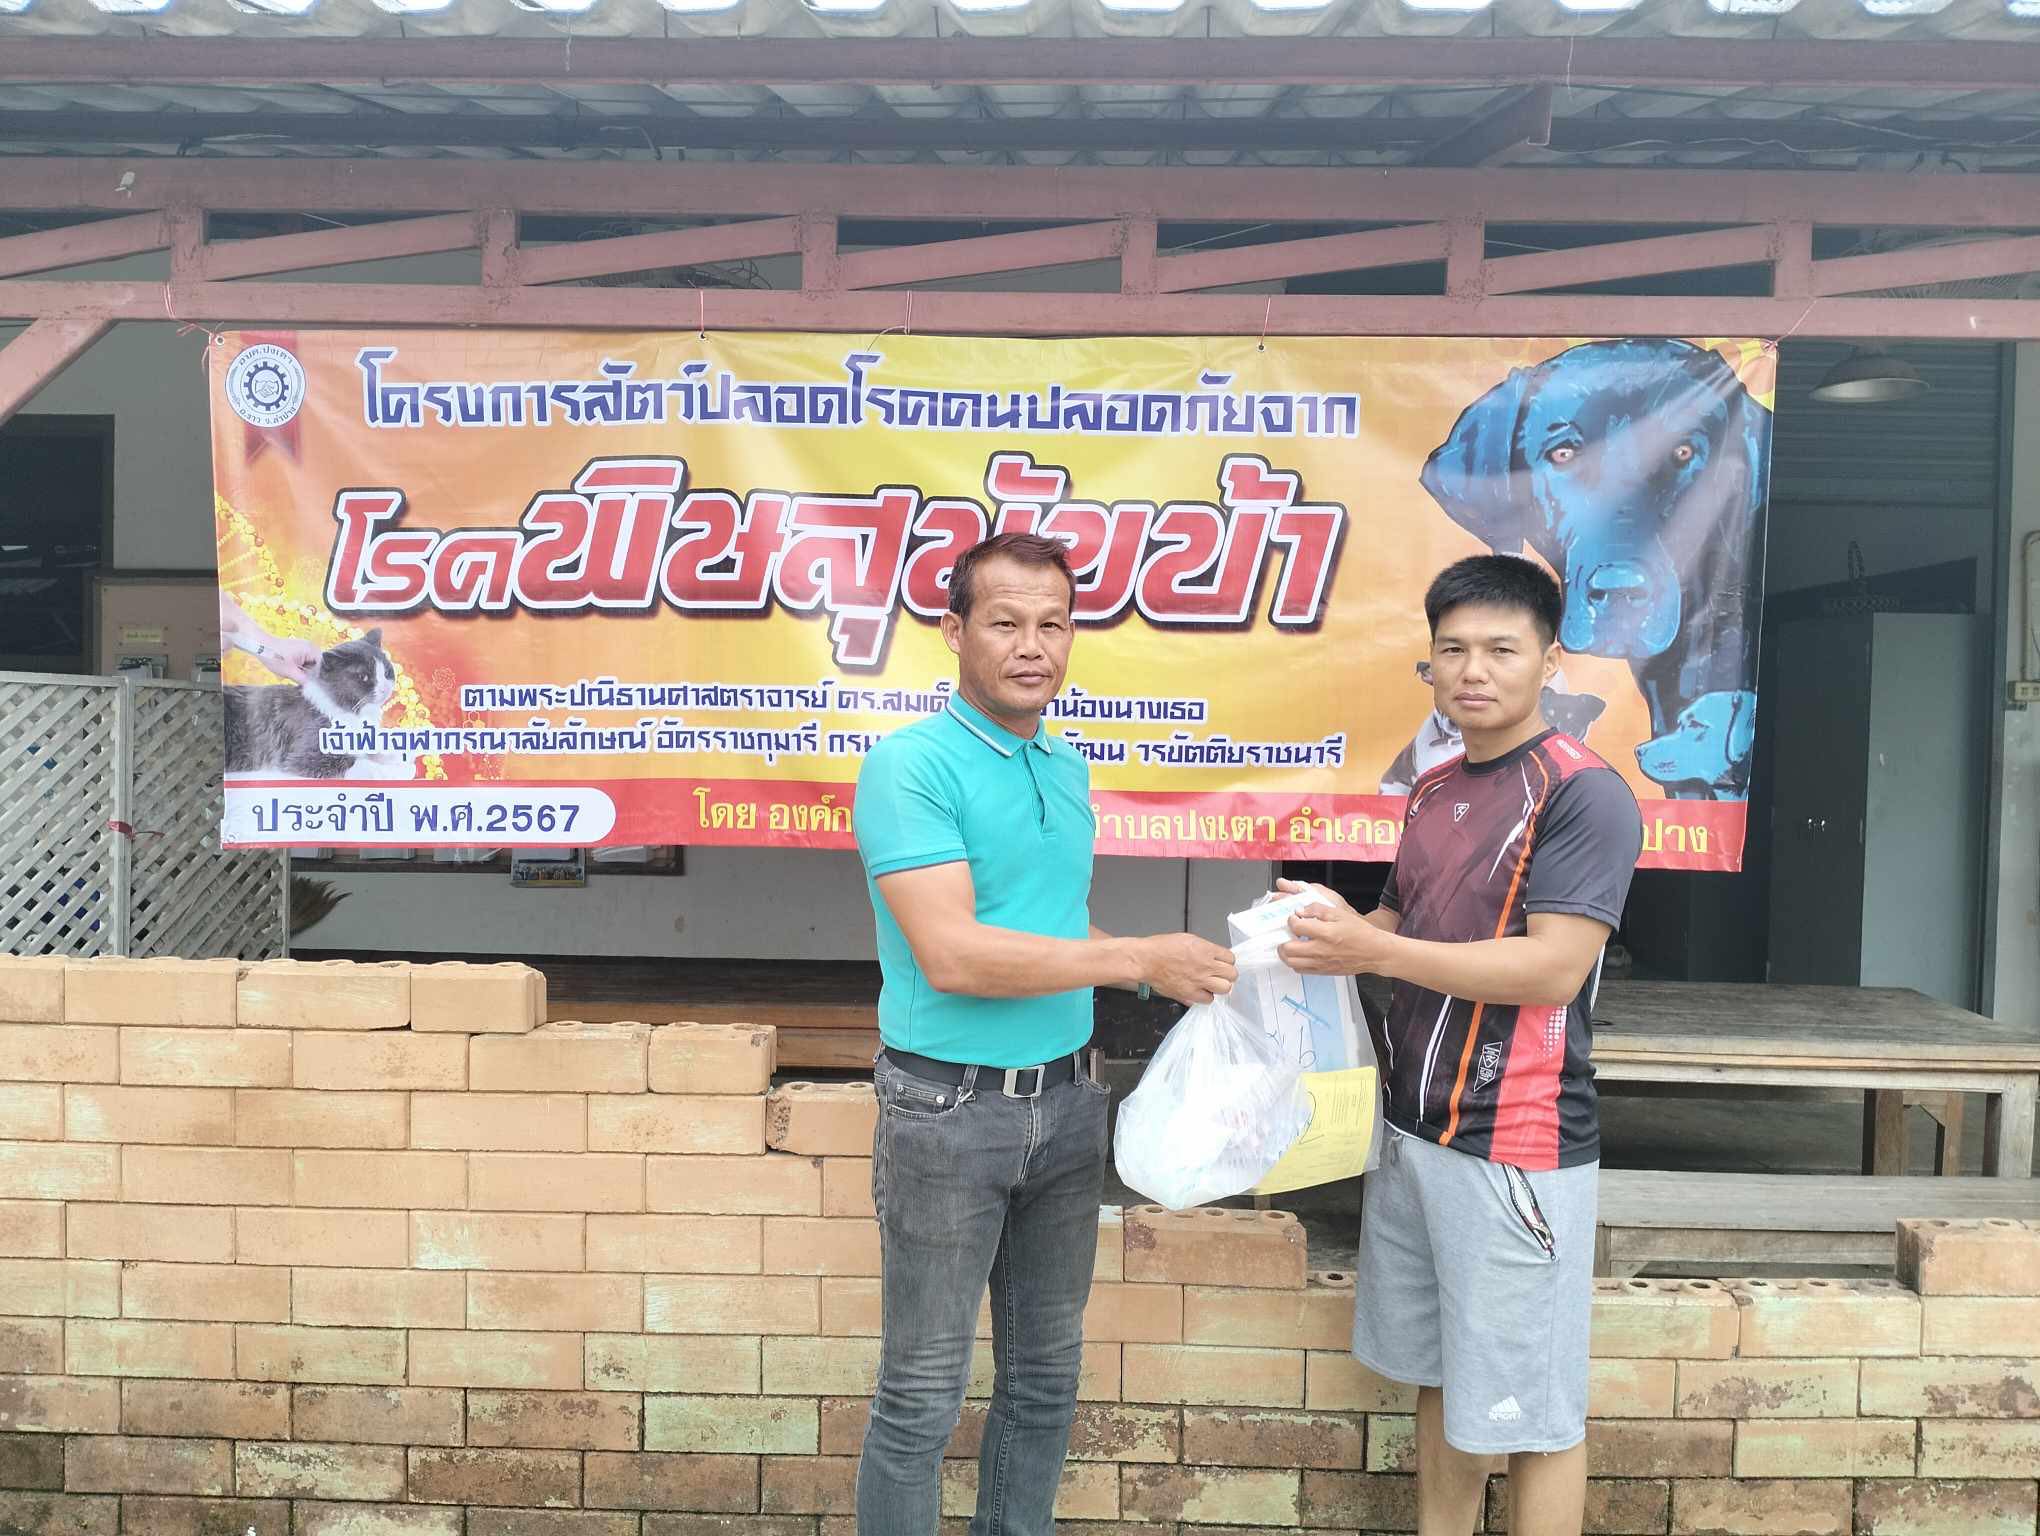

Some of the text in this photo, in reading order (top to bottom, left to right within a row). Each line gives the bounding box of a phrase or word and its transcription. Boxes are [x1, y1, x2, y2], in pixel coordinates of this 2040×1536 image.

[463, 679, 1205, 722] ตามพระปณิธานศาสตราจารย์ ดร.สมเด็ าน้องนางเธอ
[656, 719, 818, 762] อัครราชกุมารี
[251, 791, 581, 833] ประจำปี พ.ศ.2567
[692, 785, 1709, 854] โดย องค์ก ำบลปงเตา อำเภอ ปาง
